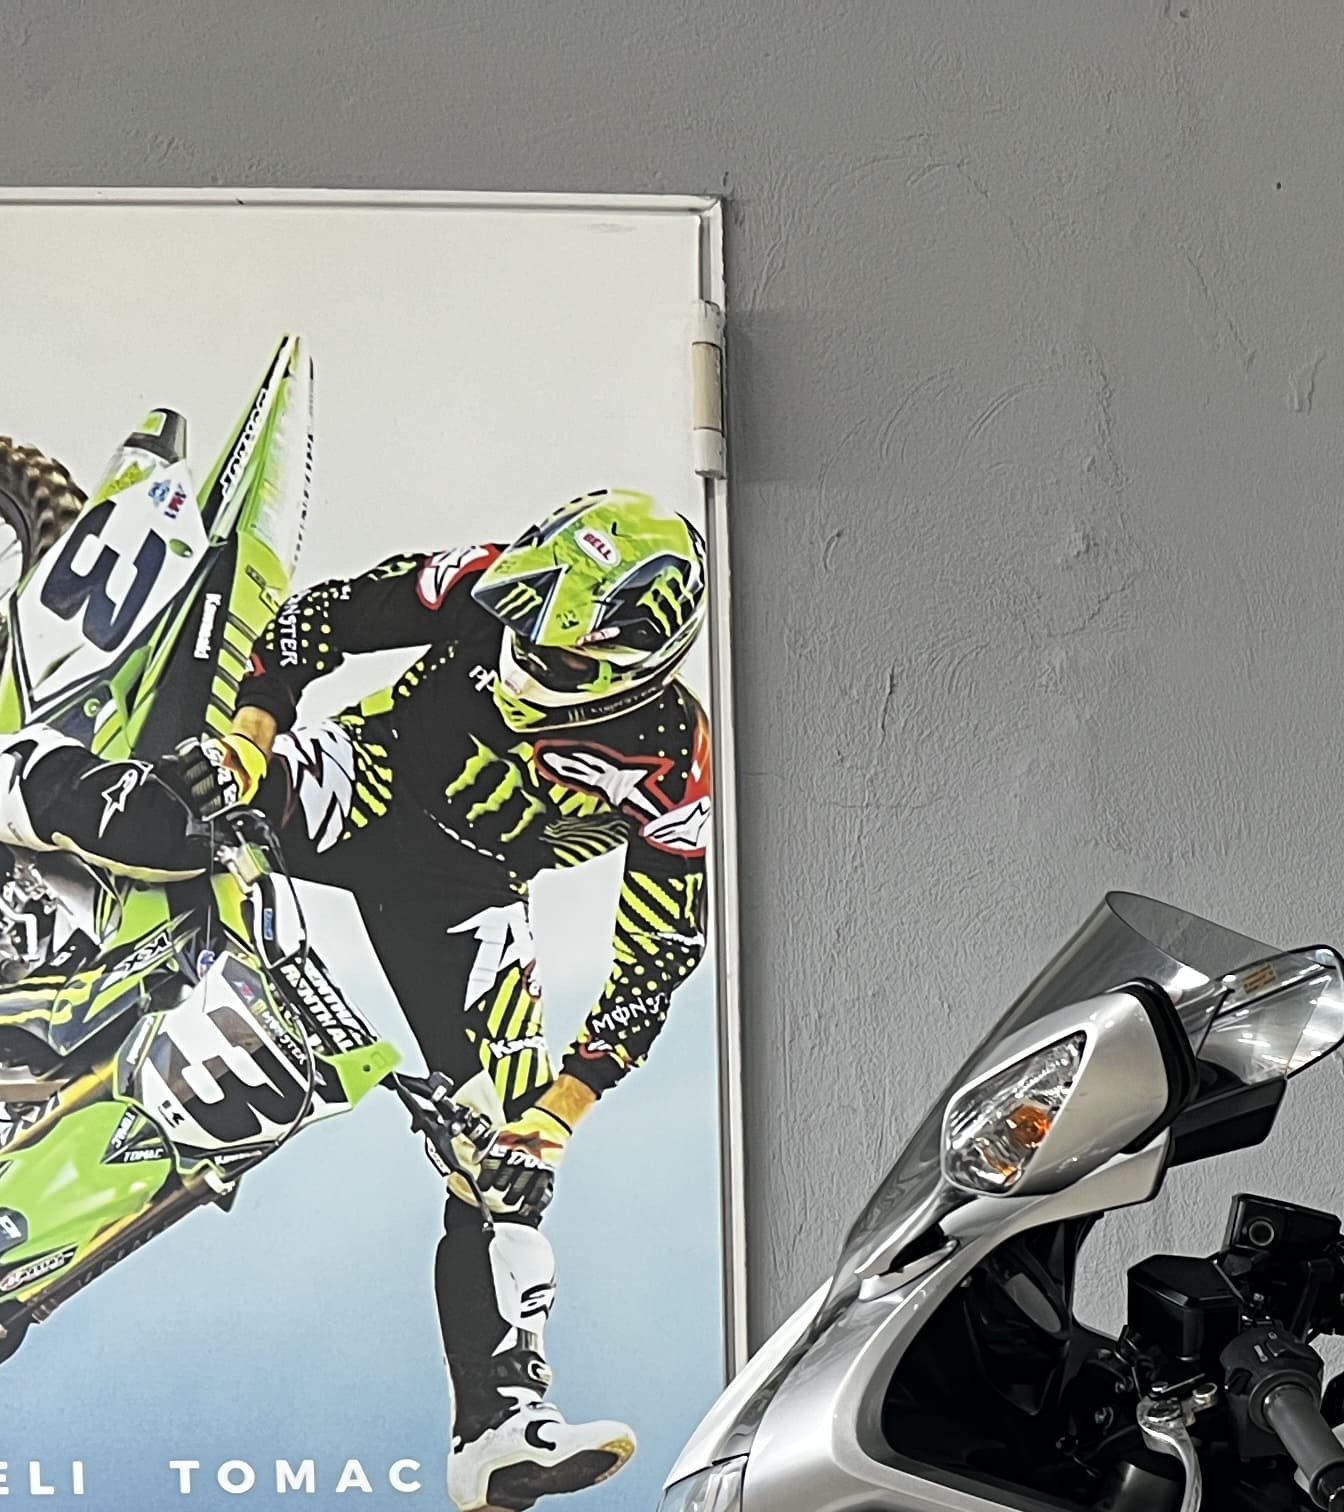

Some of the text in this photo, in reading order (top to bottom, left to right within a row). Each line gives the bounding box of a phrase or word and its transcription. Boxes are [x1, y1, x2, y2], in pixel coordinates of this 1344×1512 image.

[40, 499, 167, 652] 3
[583, 532, 612, 561] BELL
[280, 964, 356, 1054] RENTHAL
[149, 1006, 314, 1142] 3
[170, 1459, 420, 1493] TOMAC
